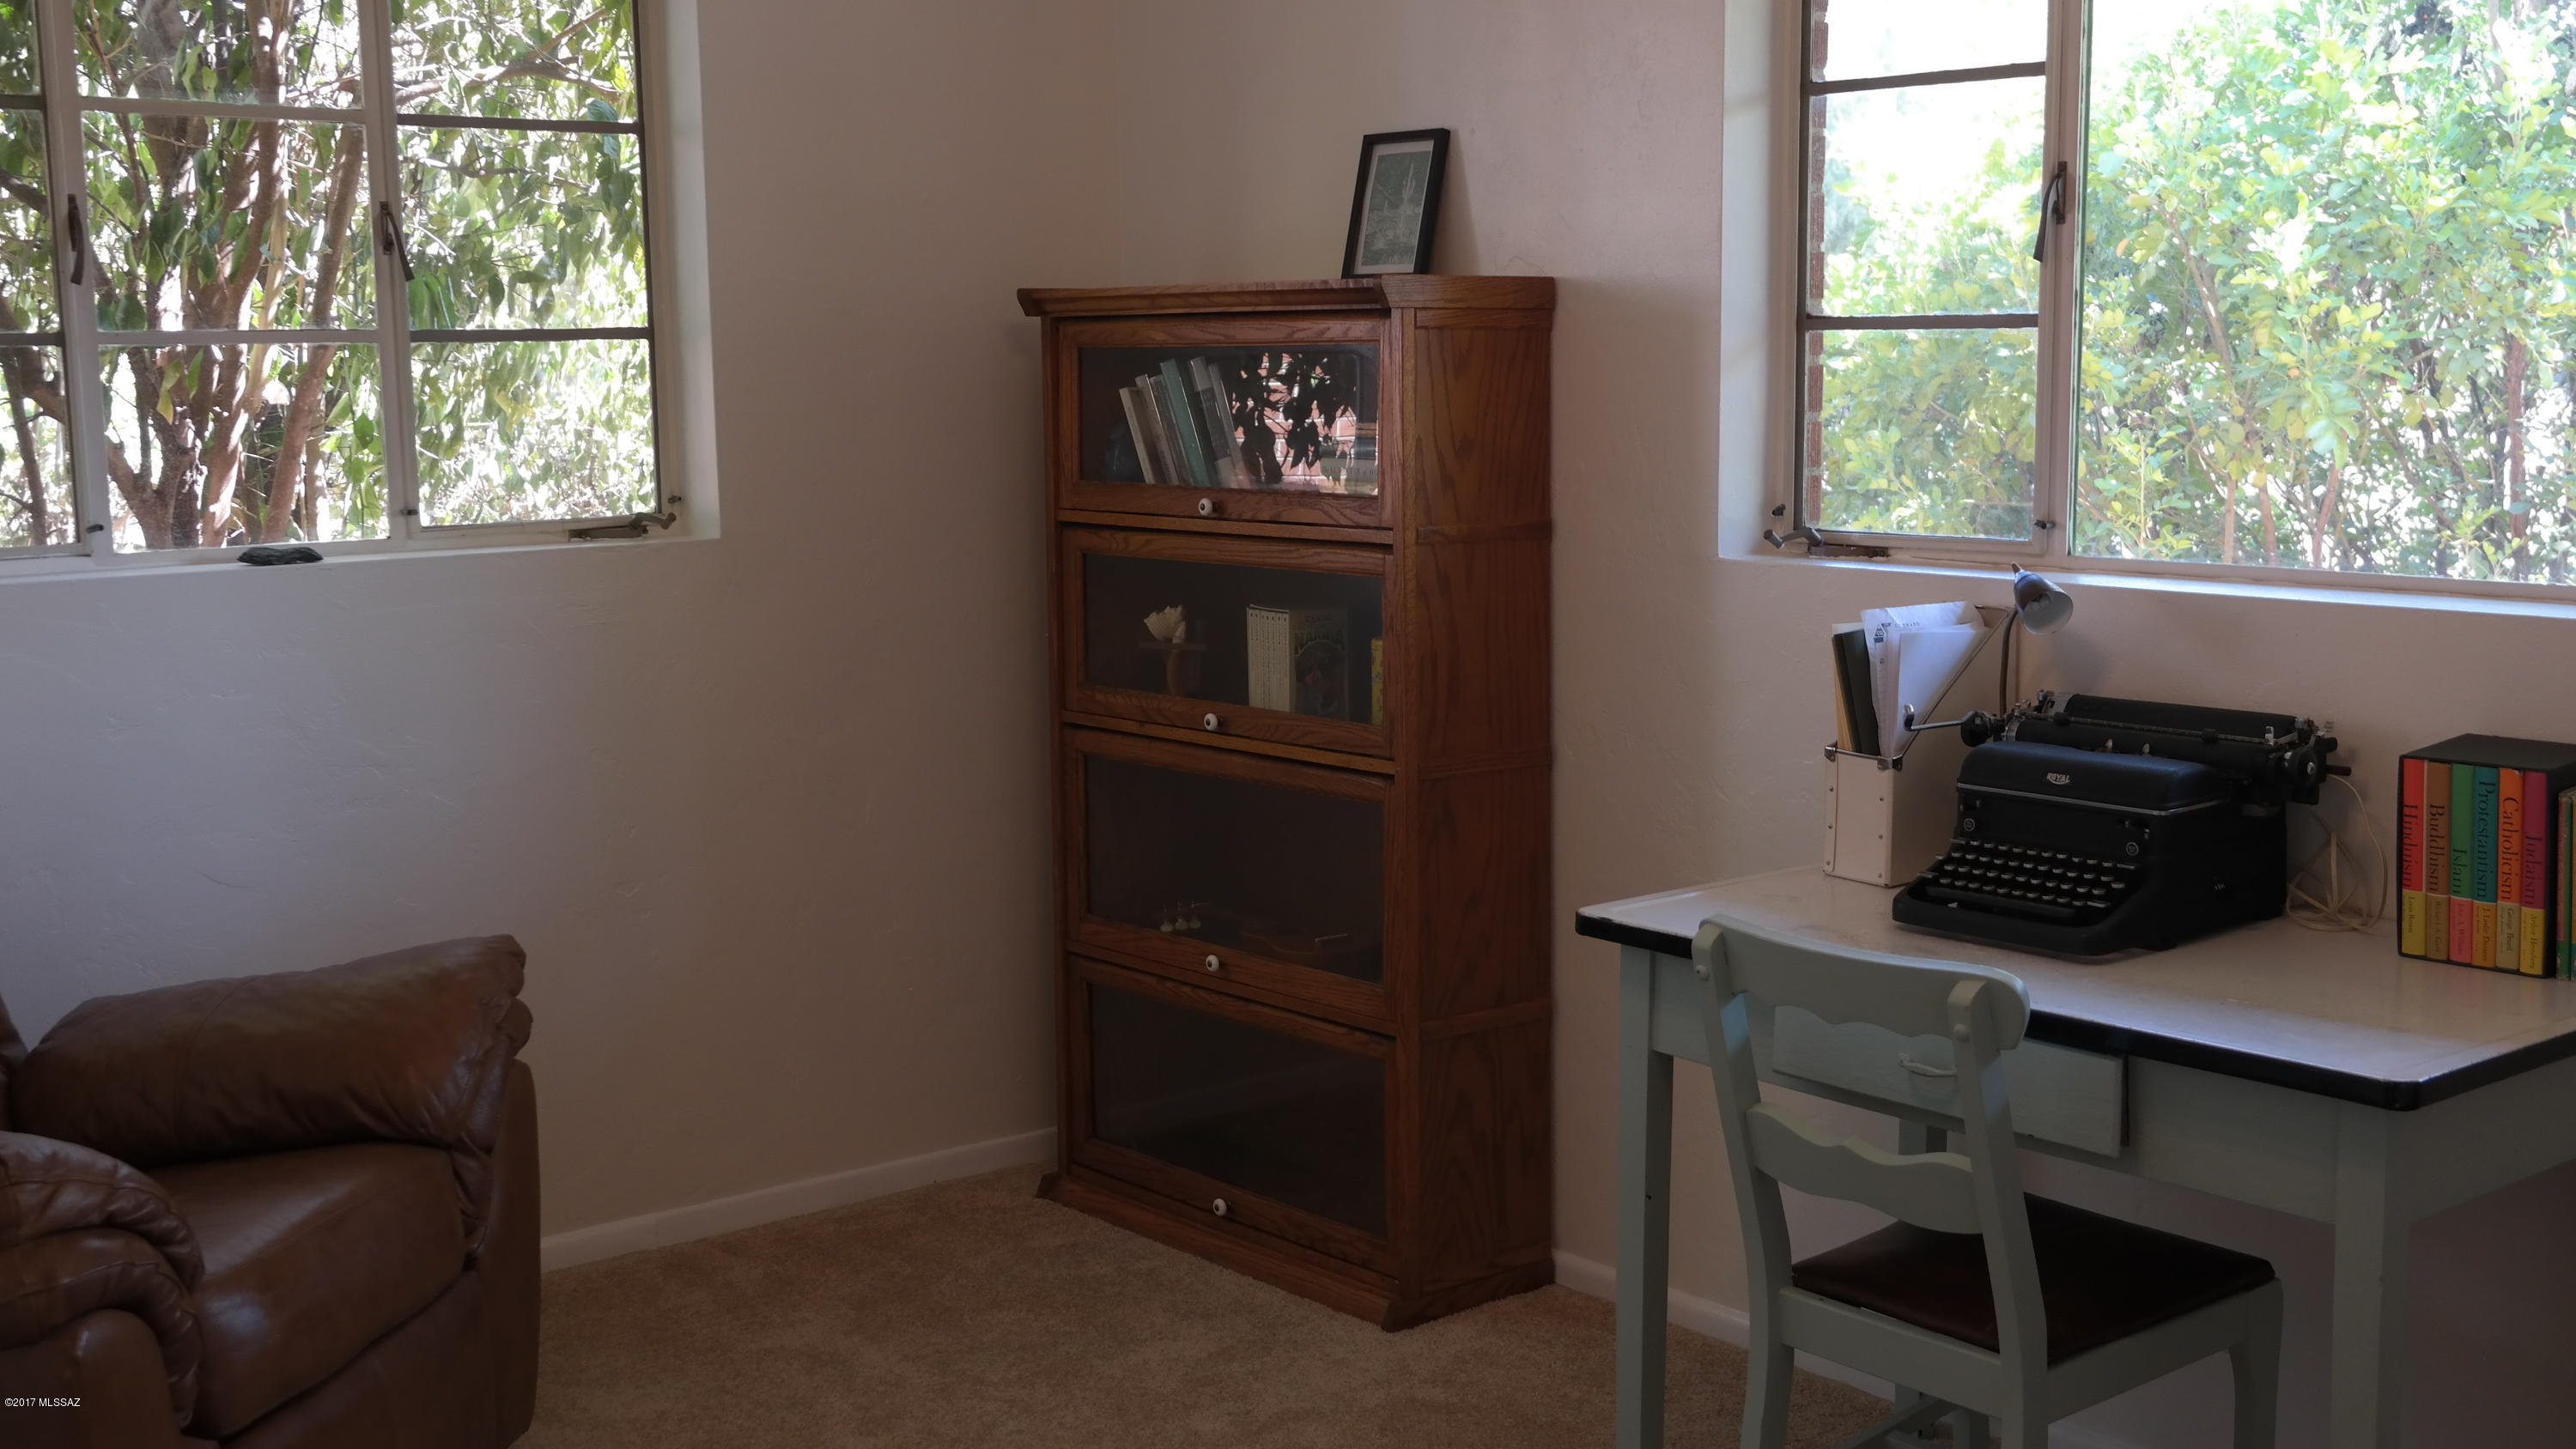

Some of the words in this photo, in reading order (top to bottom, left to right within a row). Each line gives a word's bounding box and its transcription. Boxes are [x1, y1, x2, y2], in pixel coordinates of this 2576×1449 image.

[2046, 772, 2071, 785] ROYAL
[2403, 803, 2419, 888] Hinduism
[2428, 804, 2445, 892] Buddhism
[2452, 847, 2467, 894] Islam
[2476, 780, 2495, 899] Protestantism
[2501, 797, 2519, 900] Catholicism
[2524, 834, 2543, 905] Judaism
